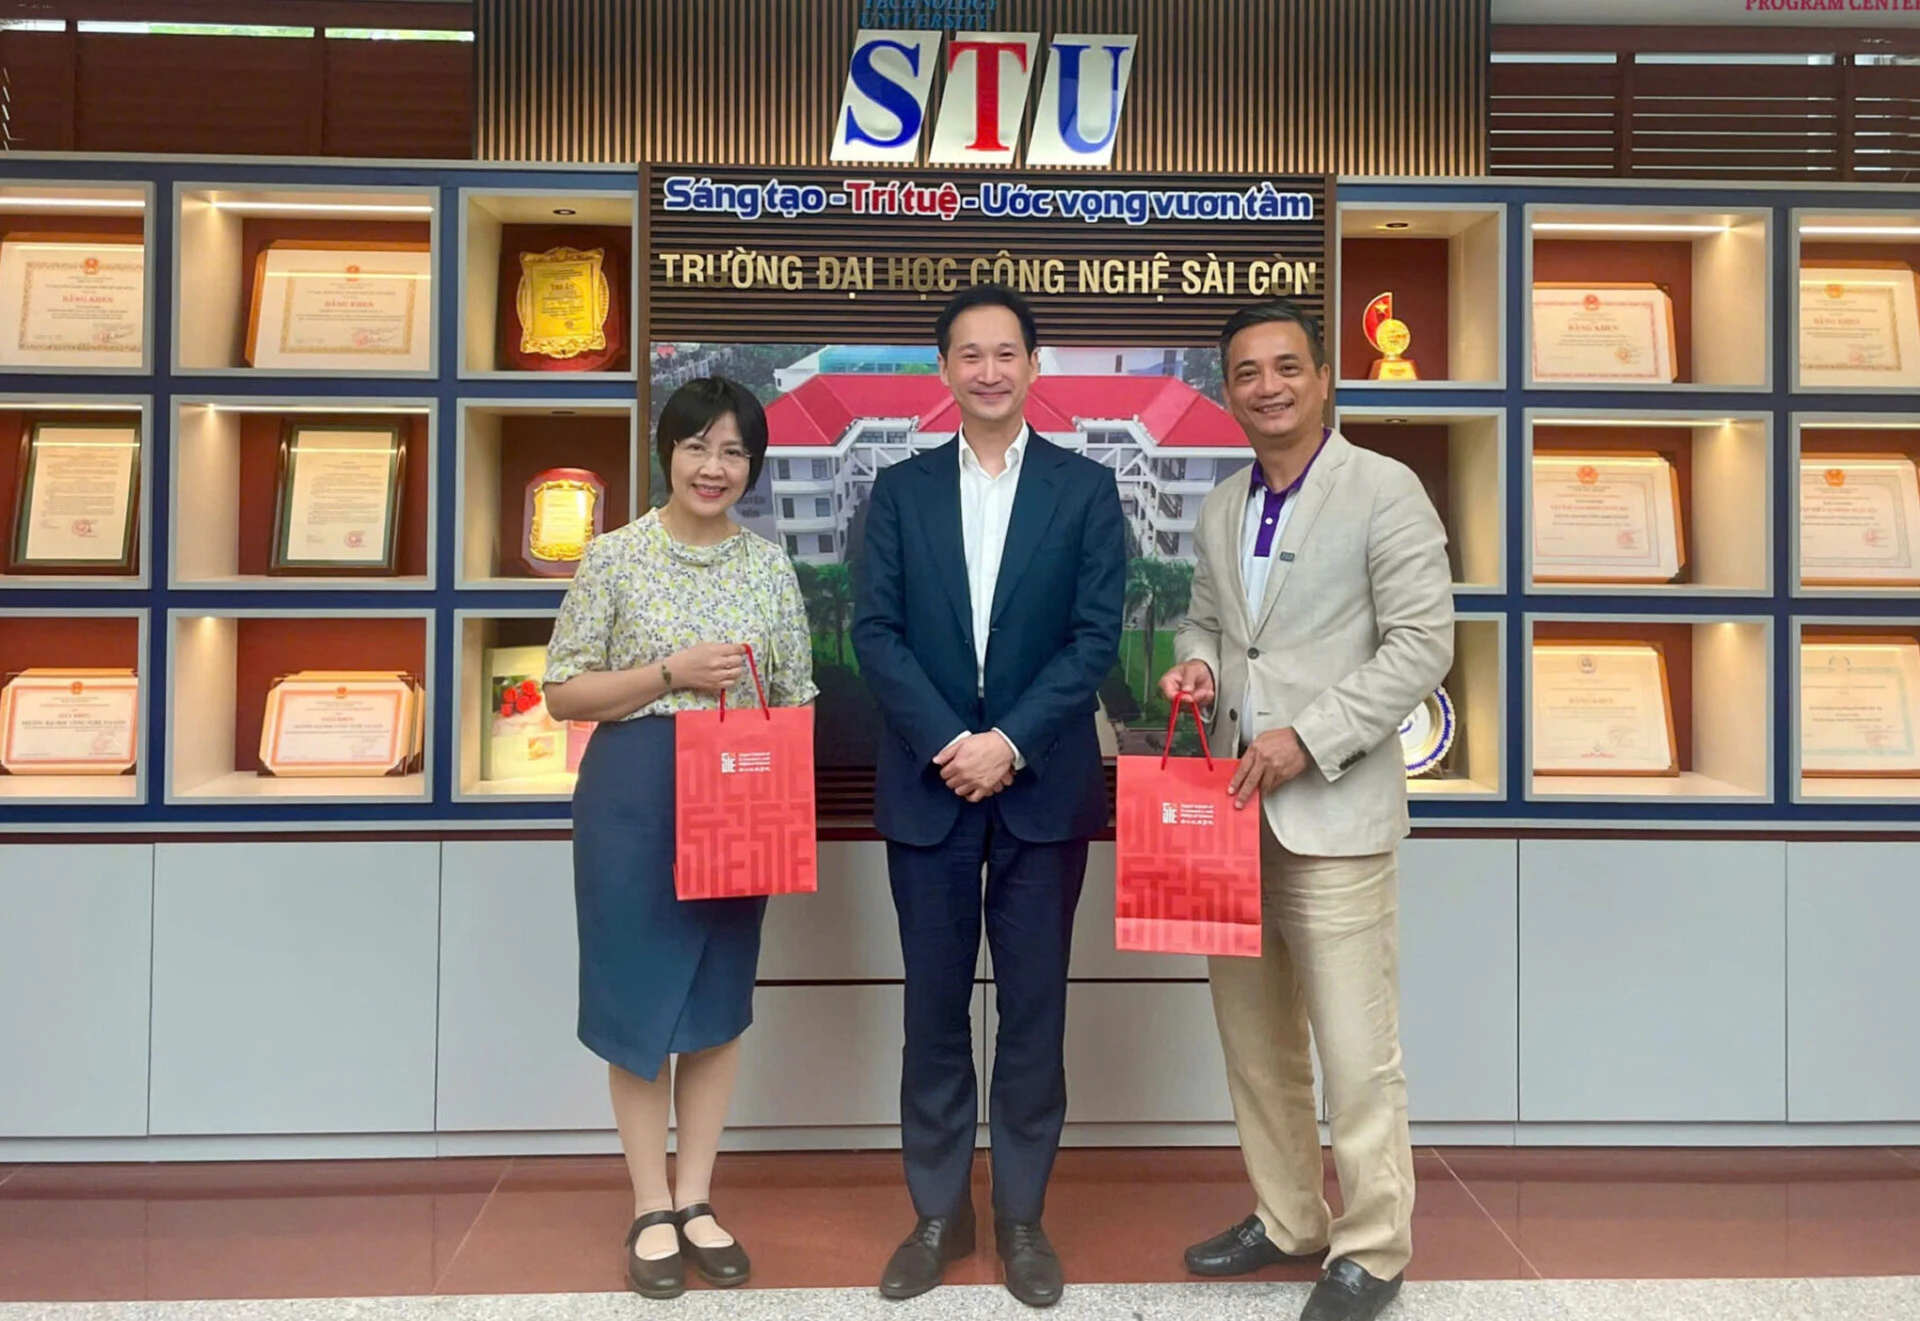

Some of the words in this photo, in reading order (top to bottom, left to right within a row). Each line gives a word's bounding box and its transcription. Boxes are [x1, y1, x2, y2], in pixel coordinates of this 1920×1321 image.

[859, 12, 989, 29] UNIVERSITY
[864, 0, 996, 10] TECHNOLOGY
[1745, 0, 1844, 11] PROGRAM
[845, 39, 1130, 154] STU
[664, 177, 760, 220] Sáng
[763, 179, 826, 218] tạo
[844, 180, 899, 214] Trí
[900, 181, 960, 220] tuệ
[1056, 189, 1149, 225] vọng
[1243, 182, 1313, 219] tầm
[659, 247, 803, 290] TRƯỜNG
[817, 256, 874, 299] ĐẠI
[888, 256, 957, 300] HỌC
[970, 249, 1065, 294] CÔNG
[1078, 252, 1170, 302] NGHỆ
[1181, 253, 1235, 295] SÀI
[1248, 253, 1316, 296] GÒN
